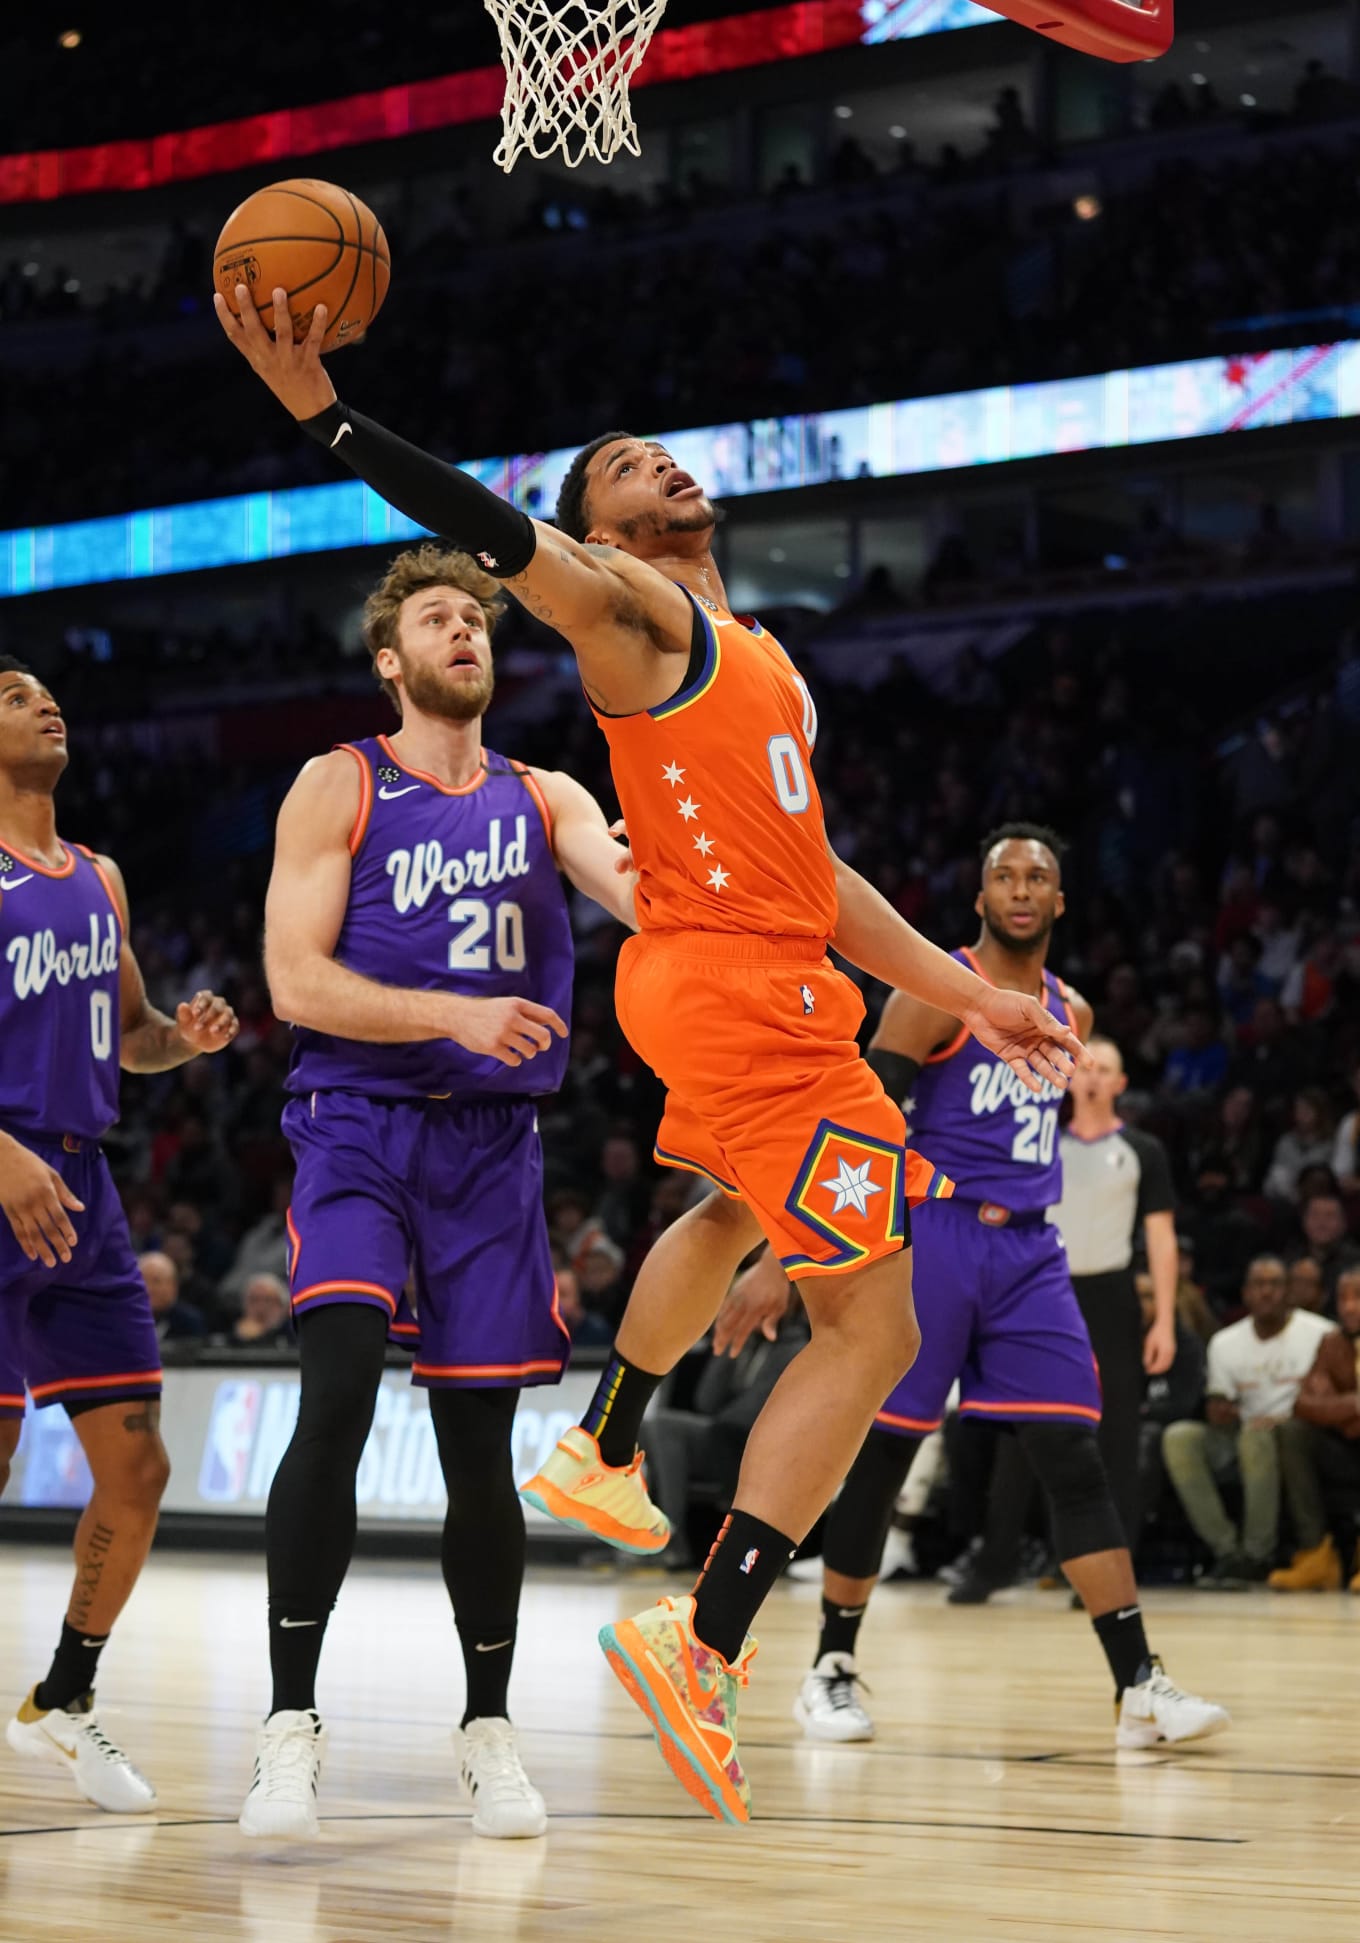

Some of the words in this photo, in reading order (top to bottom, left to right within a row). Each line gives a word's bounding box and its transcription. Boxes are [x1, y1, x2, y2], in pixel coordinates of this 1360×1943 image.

[767, 733, 809, 815] 0
[386, 816, 530, 914] World
[5, 913, 119, 1000] World
[448, 900, 526, 973] 20
[89, 990, 112, 1062] 0
[1012, 1105, 1058, 1165] 20
